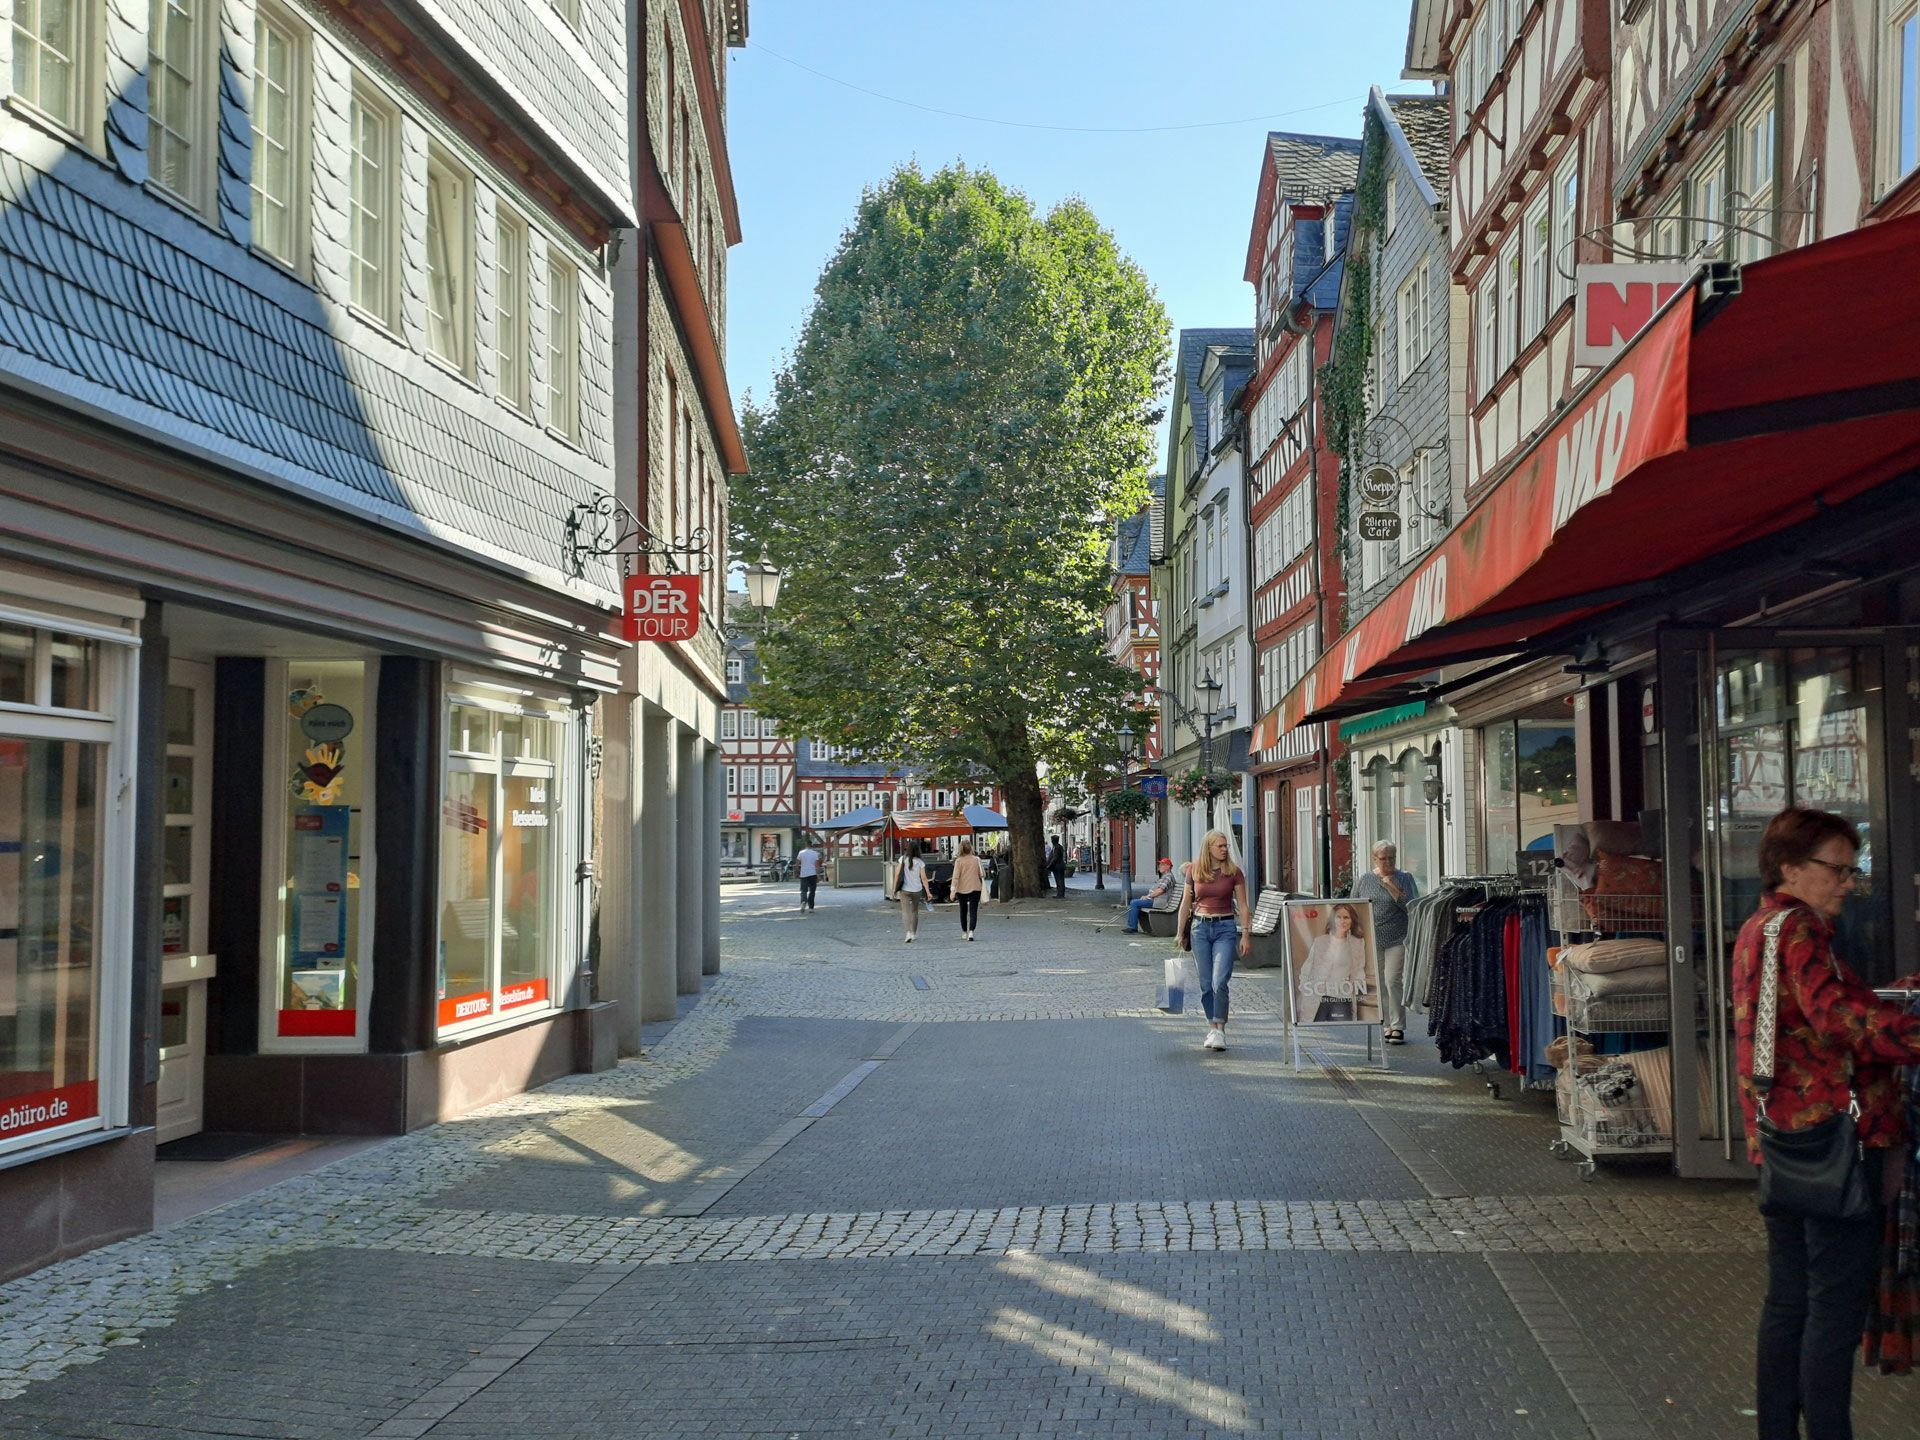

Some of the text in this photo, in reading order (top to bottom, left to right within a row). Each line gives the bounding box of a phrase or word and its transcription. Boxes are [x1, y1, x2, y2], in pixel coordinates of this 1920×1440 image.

[1365, 516, 1398, 527] Wiener
[633, 589, 689, 614] DER
[633, 618, 689, 637] TOUR
